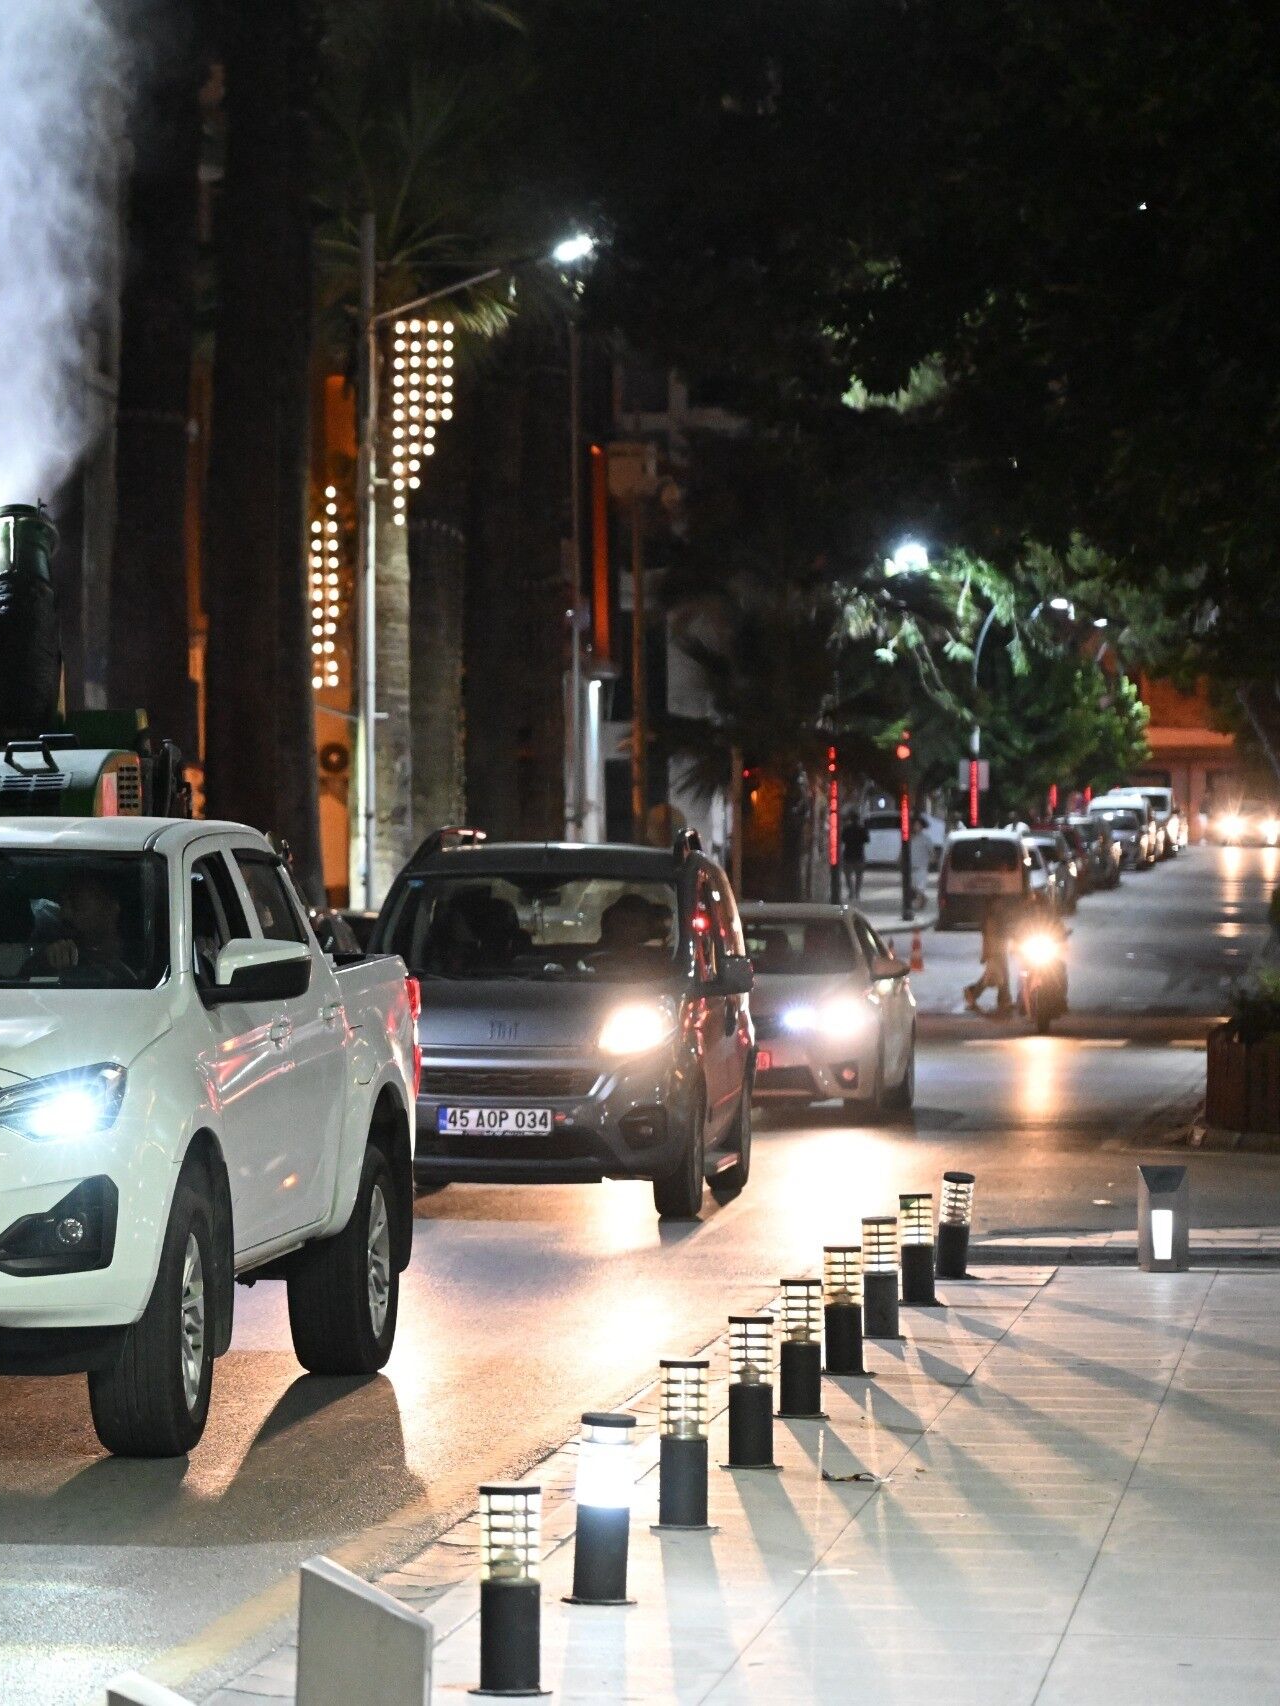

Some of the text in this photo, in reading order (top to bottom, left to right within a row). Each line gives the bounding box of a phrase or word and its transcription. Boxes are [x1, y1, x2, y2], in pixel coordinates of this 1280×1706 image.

[448, 1110, 469, 1127] 45
[476, 1111, 509, 1128] AOP
[515, 1112, 549, 1129] 034
